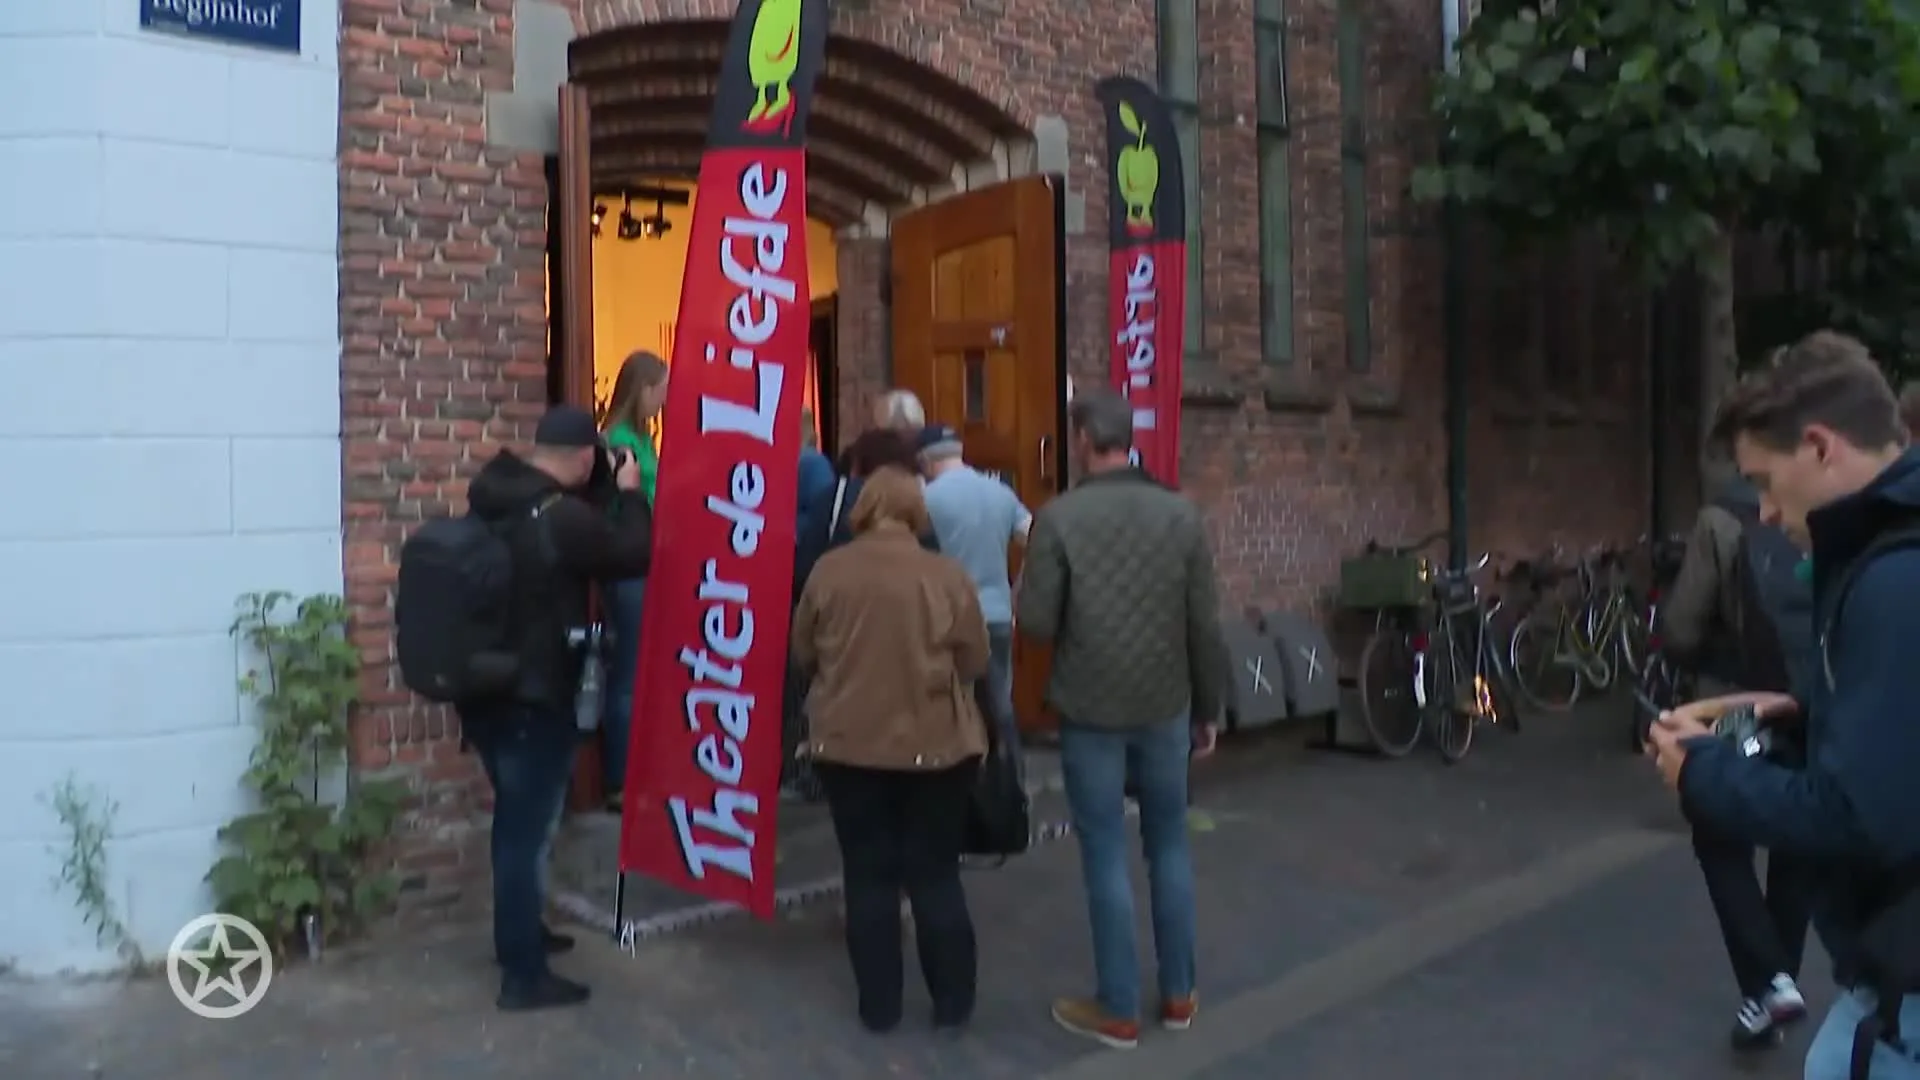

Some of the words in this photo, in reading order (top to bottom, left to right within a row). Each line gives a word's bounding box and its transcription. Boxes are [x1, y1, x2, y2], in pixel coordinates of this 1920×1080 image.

[700, 161, 797, 447] Liefde
[706, 460, 766, 558] de
[668, 558, 759, 882] Theater
